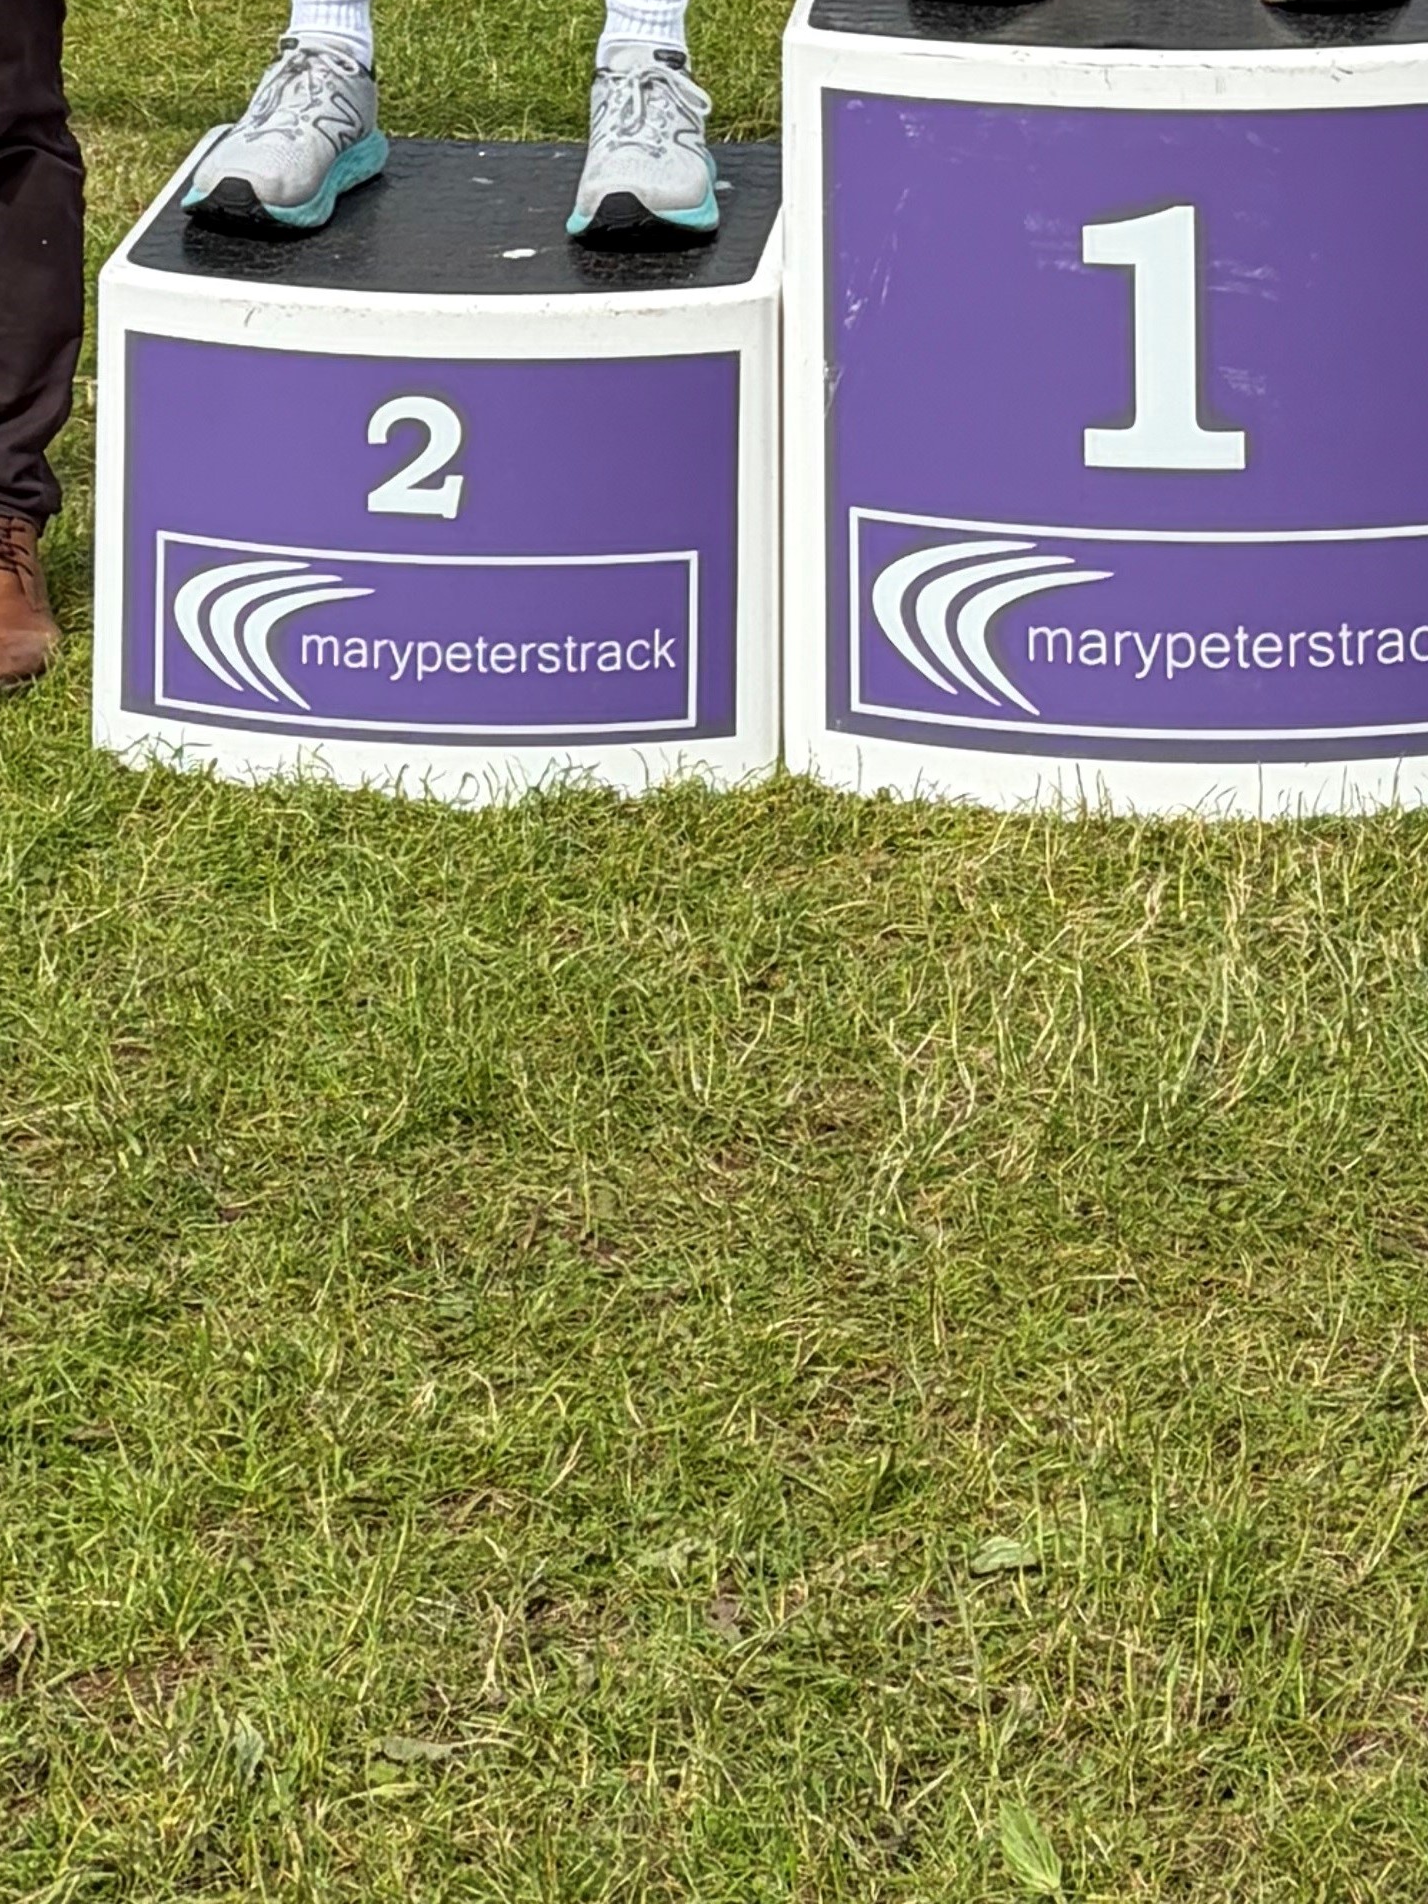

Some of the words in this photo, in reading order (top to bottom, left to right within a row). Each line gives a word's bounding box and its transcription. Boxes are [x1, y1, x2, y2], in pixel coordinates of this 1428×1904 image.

[1080, 204, 1247, 471] 1
[366, 395, 465, 520] 2
[300, 627, 678, 682] marypeterstrack
